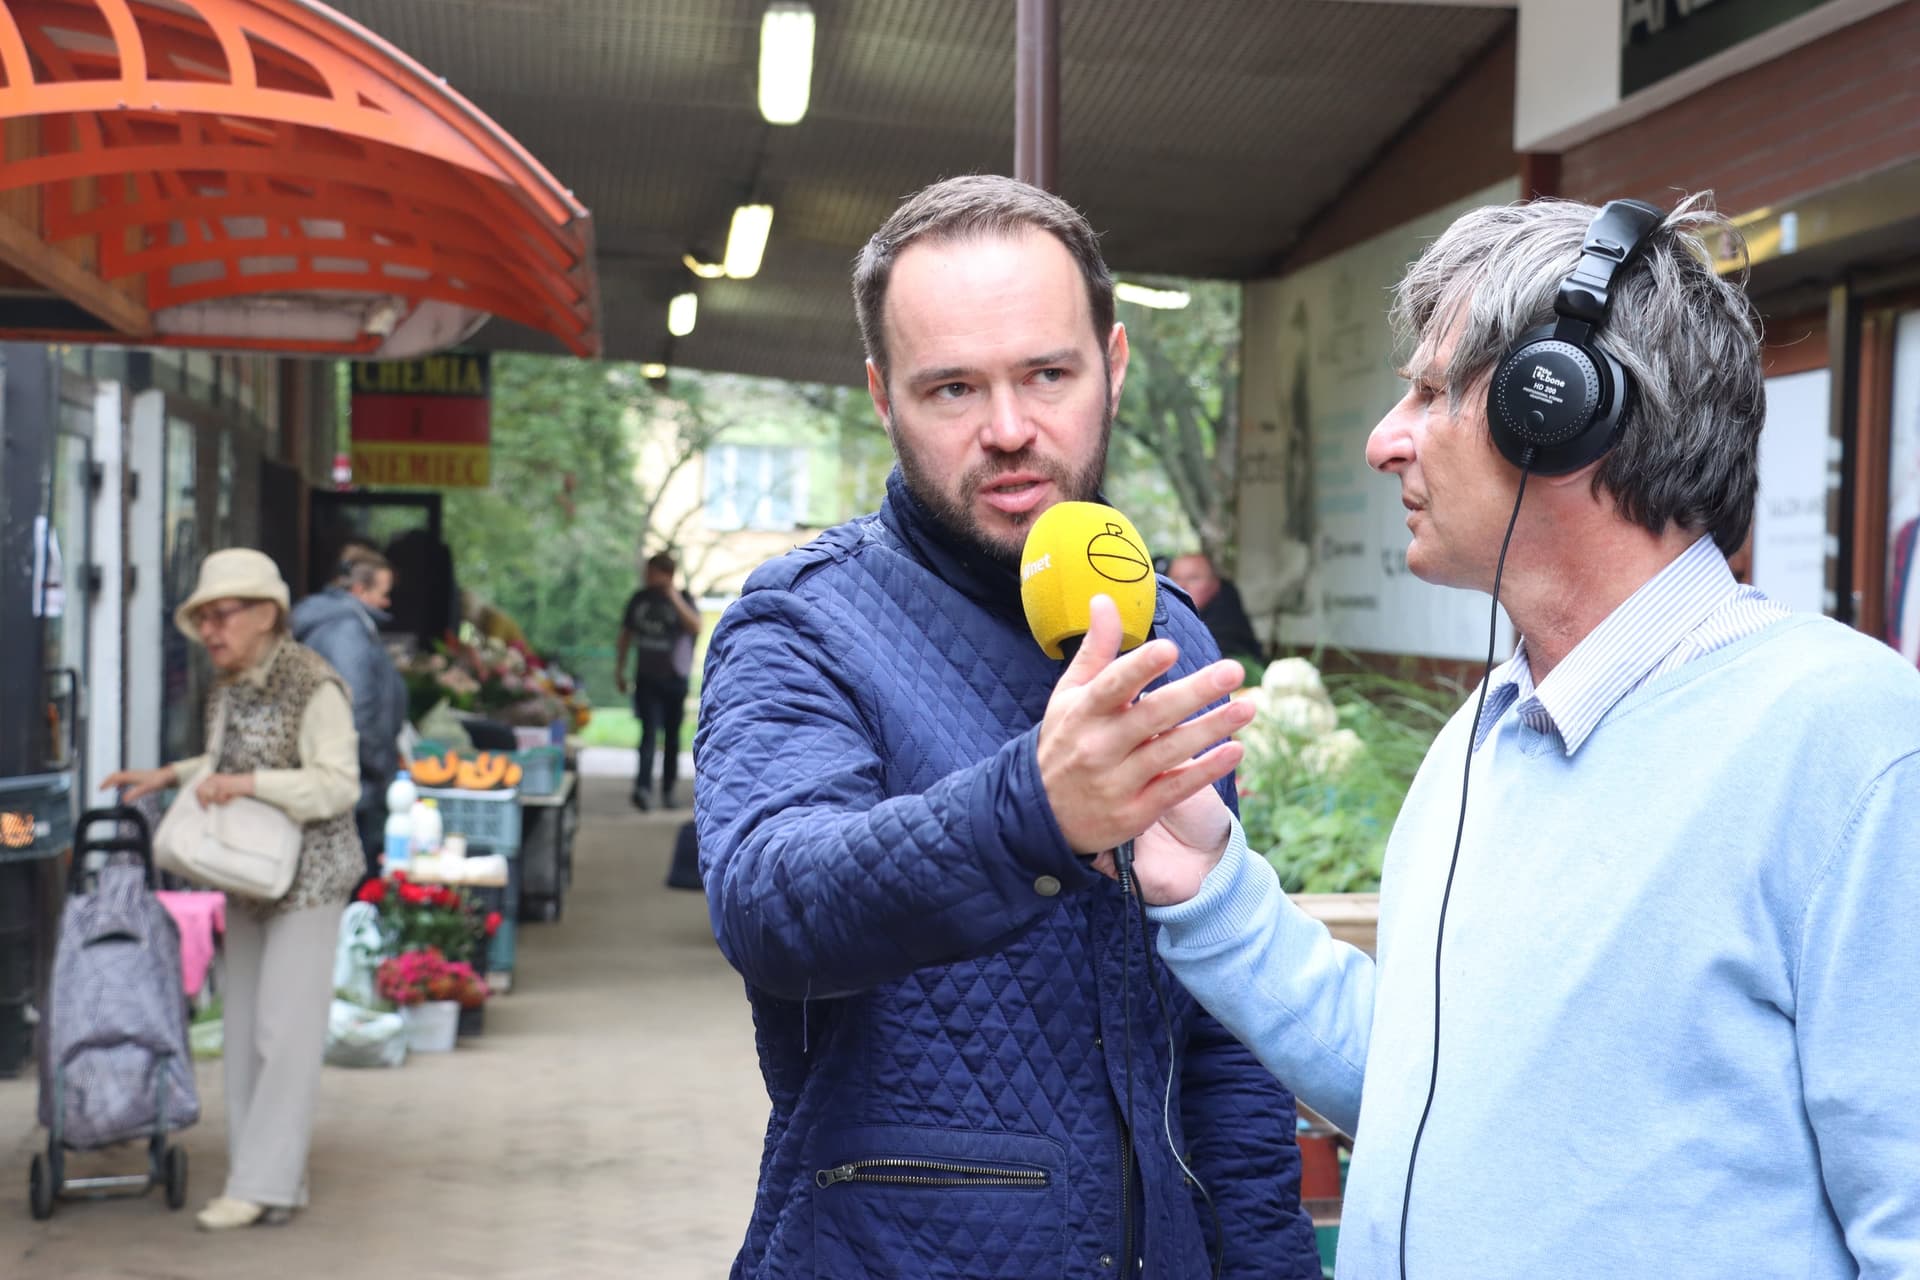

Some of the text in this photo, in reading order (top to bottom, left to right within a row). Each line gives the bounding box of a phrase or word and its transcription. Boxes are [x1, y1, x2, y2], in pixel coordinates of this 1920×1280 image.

[356, 357, 482, 391] CHEMIA
[1533, 382, 1545, 391] HD
[354, 452, 484, 486] NIEMIEC
